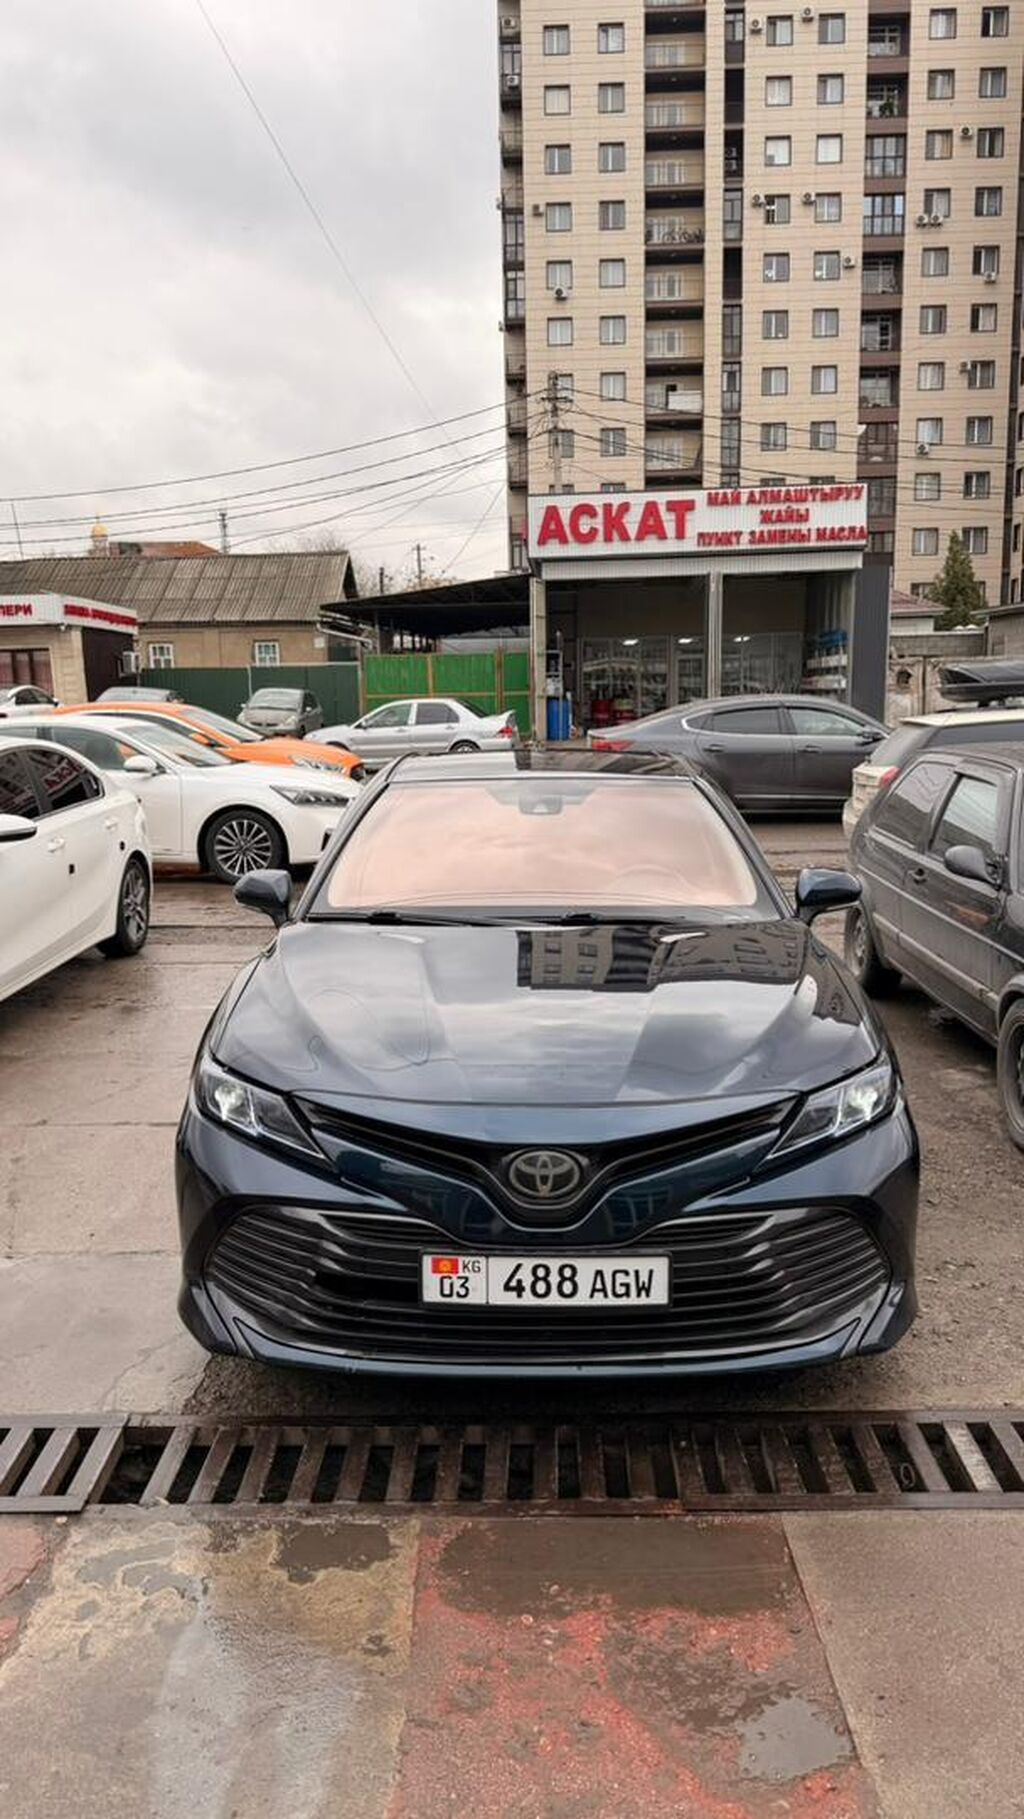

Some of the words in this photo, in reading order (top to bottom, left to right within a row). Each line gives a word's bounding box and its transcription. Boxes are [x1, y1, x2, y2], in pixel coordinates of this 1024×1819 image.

[707, 490, 741, 506] МАЙ
[747, 486, 864, 505] АЛМАШТЫРУУ
[537, 499, 696, 546] АСКАТ
[760, 505, 809, 524] ЖАЙЫ
[697, 531, 743, 547] ПУНКТ
[748, 528, 811, 545] ЗАМЕНЫ
[816, 526, 868, 542] МАСЛА
[462, 1260, 481, 1273] KG
[439, 1276, 470, 1299] 03
[503, 1263, 579, 1299] 488
[589, 1269, 654, 1299] AGW
